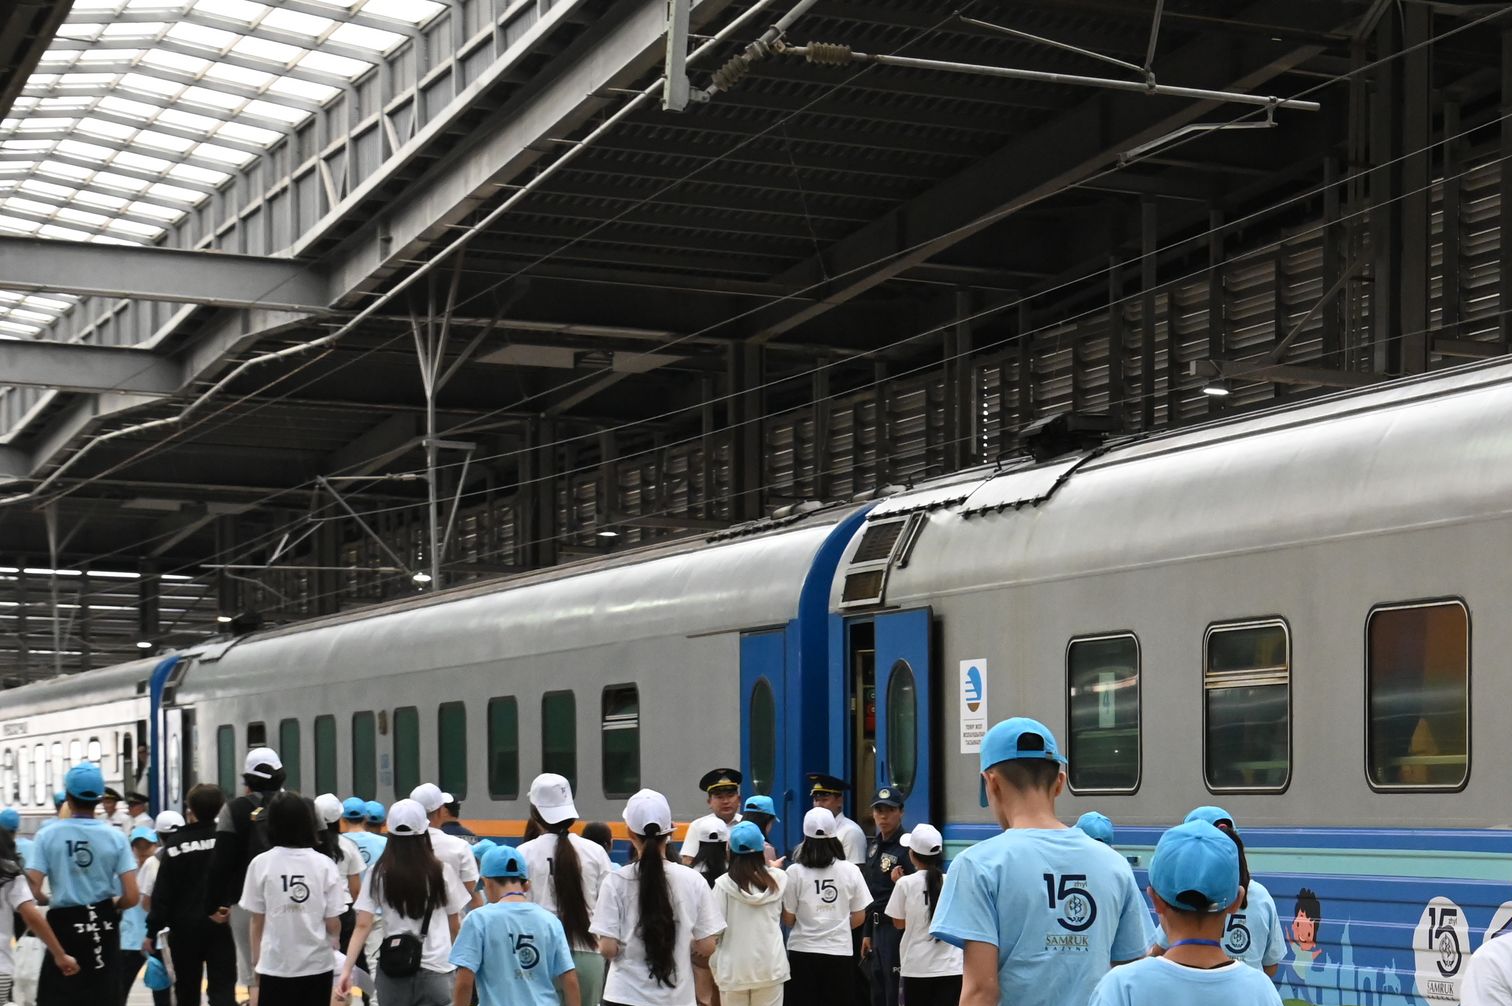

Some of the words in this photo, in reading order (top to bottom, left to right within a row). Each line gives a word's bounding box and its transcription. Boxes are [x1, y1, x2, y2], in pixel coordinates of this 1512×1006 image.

[66, 840, 93, 867] 15
[281, 875, 310, 903] 15
[814, 879, 838, 903] 15
[1043, 874, 1097, 932] 15
[509, 933, 539, 969] 15
[1046, 934, 1089, 946] SAMRUK
[1429, 907, 1462, 977] 15
